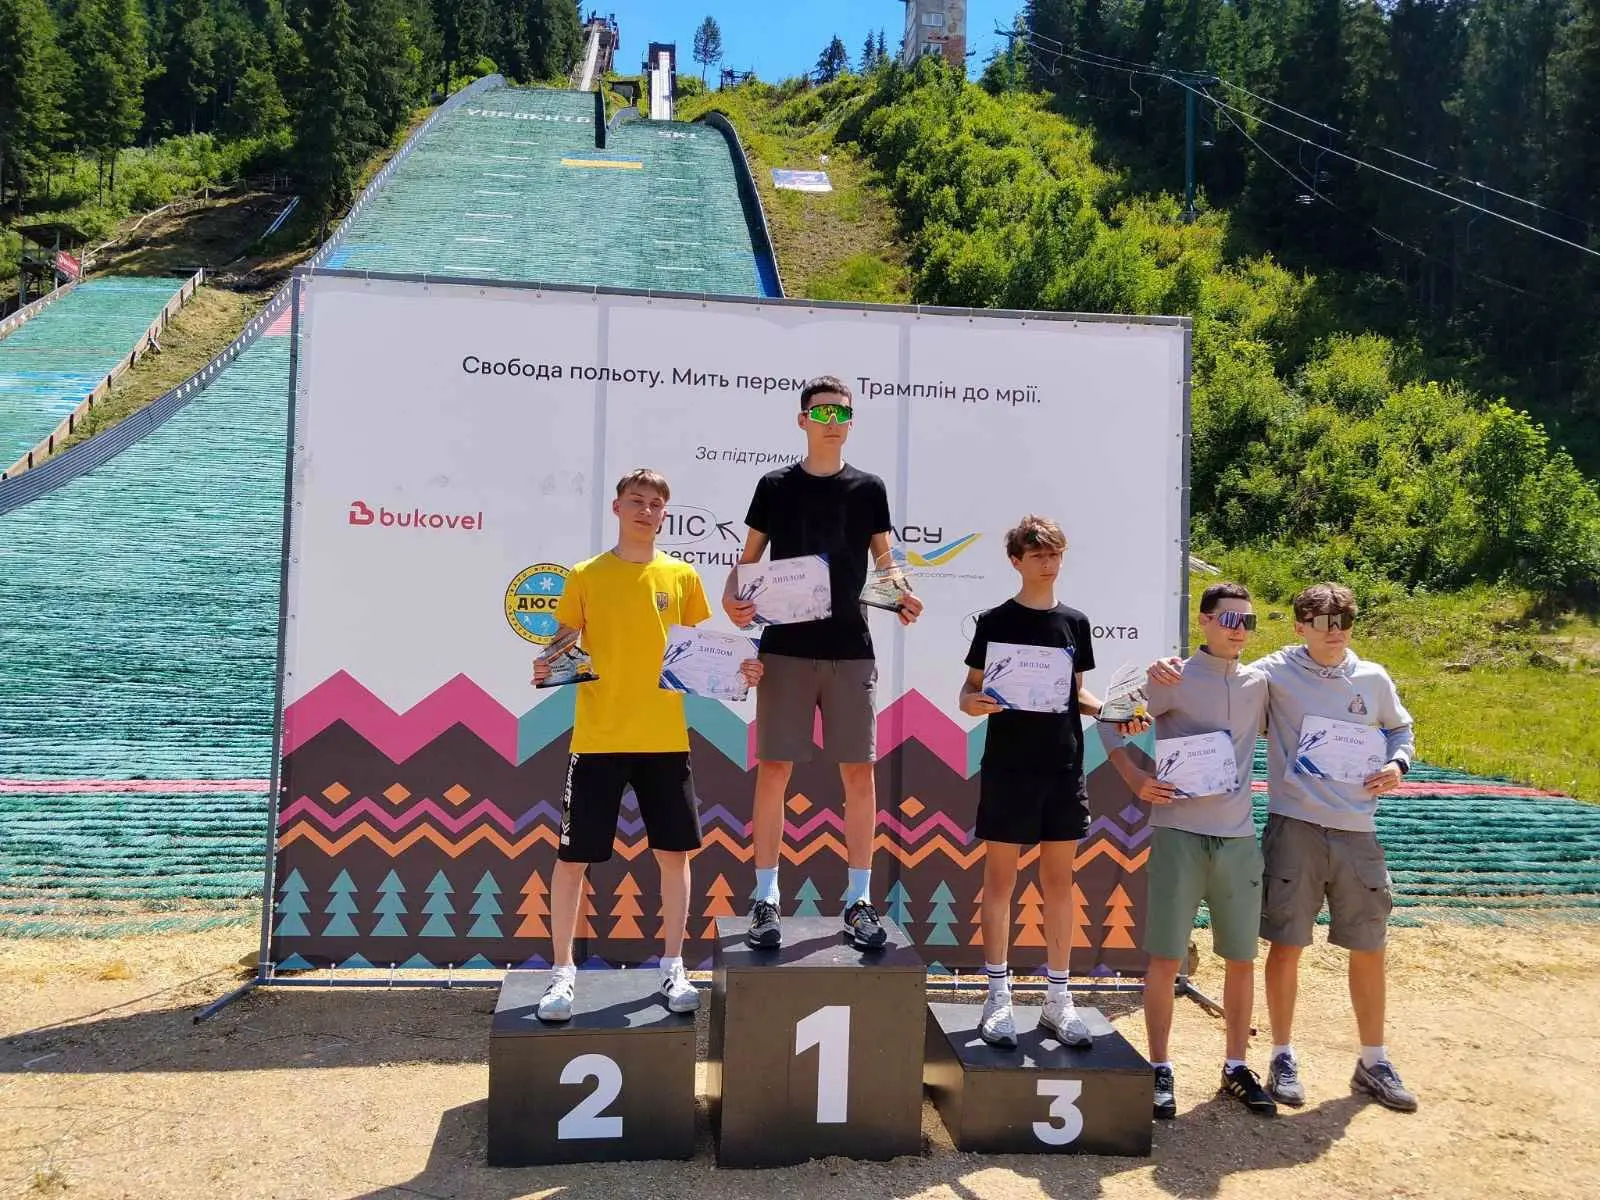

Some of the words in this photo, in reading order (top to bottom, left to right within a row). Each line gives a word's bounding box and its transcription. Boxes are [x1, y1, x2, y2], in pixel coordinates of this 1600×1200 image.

[462, 356, 563, 381] Свобода
[570, 364, 664, 388] польоту.
[672, 367, 729, 388] Мить
[736, 375, 806, 394] перем
[856, 376, 956, 399] Трамплін
[962, 387, 989, 403] до
[996, 385, 1041, 406] мрії.
[695, 446, 717, 460] За
[380, 507, 483, 530] bukovel
[518, 597, 558, 610] ДЮС
[1092, 625, 1139, 640] охта
[796, 1006, 851, 1123] 1
[558, 1054, 623, 1139] 2
[1032, 1080, 1083, 1145] 3
